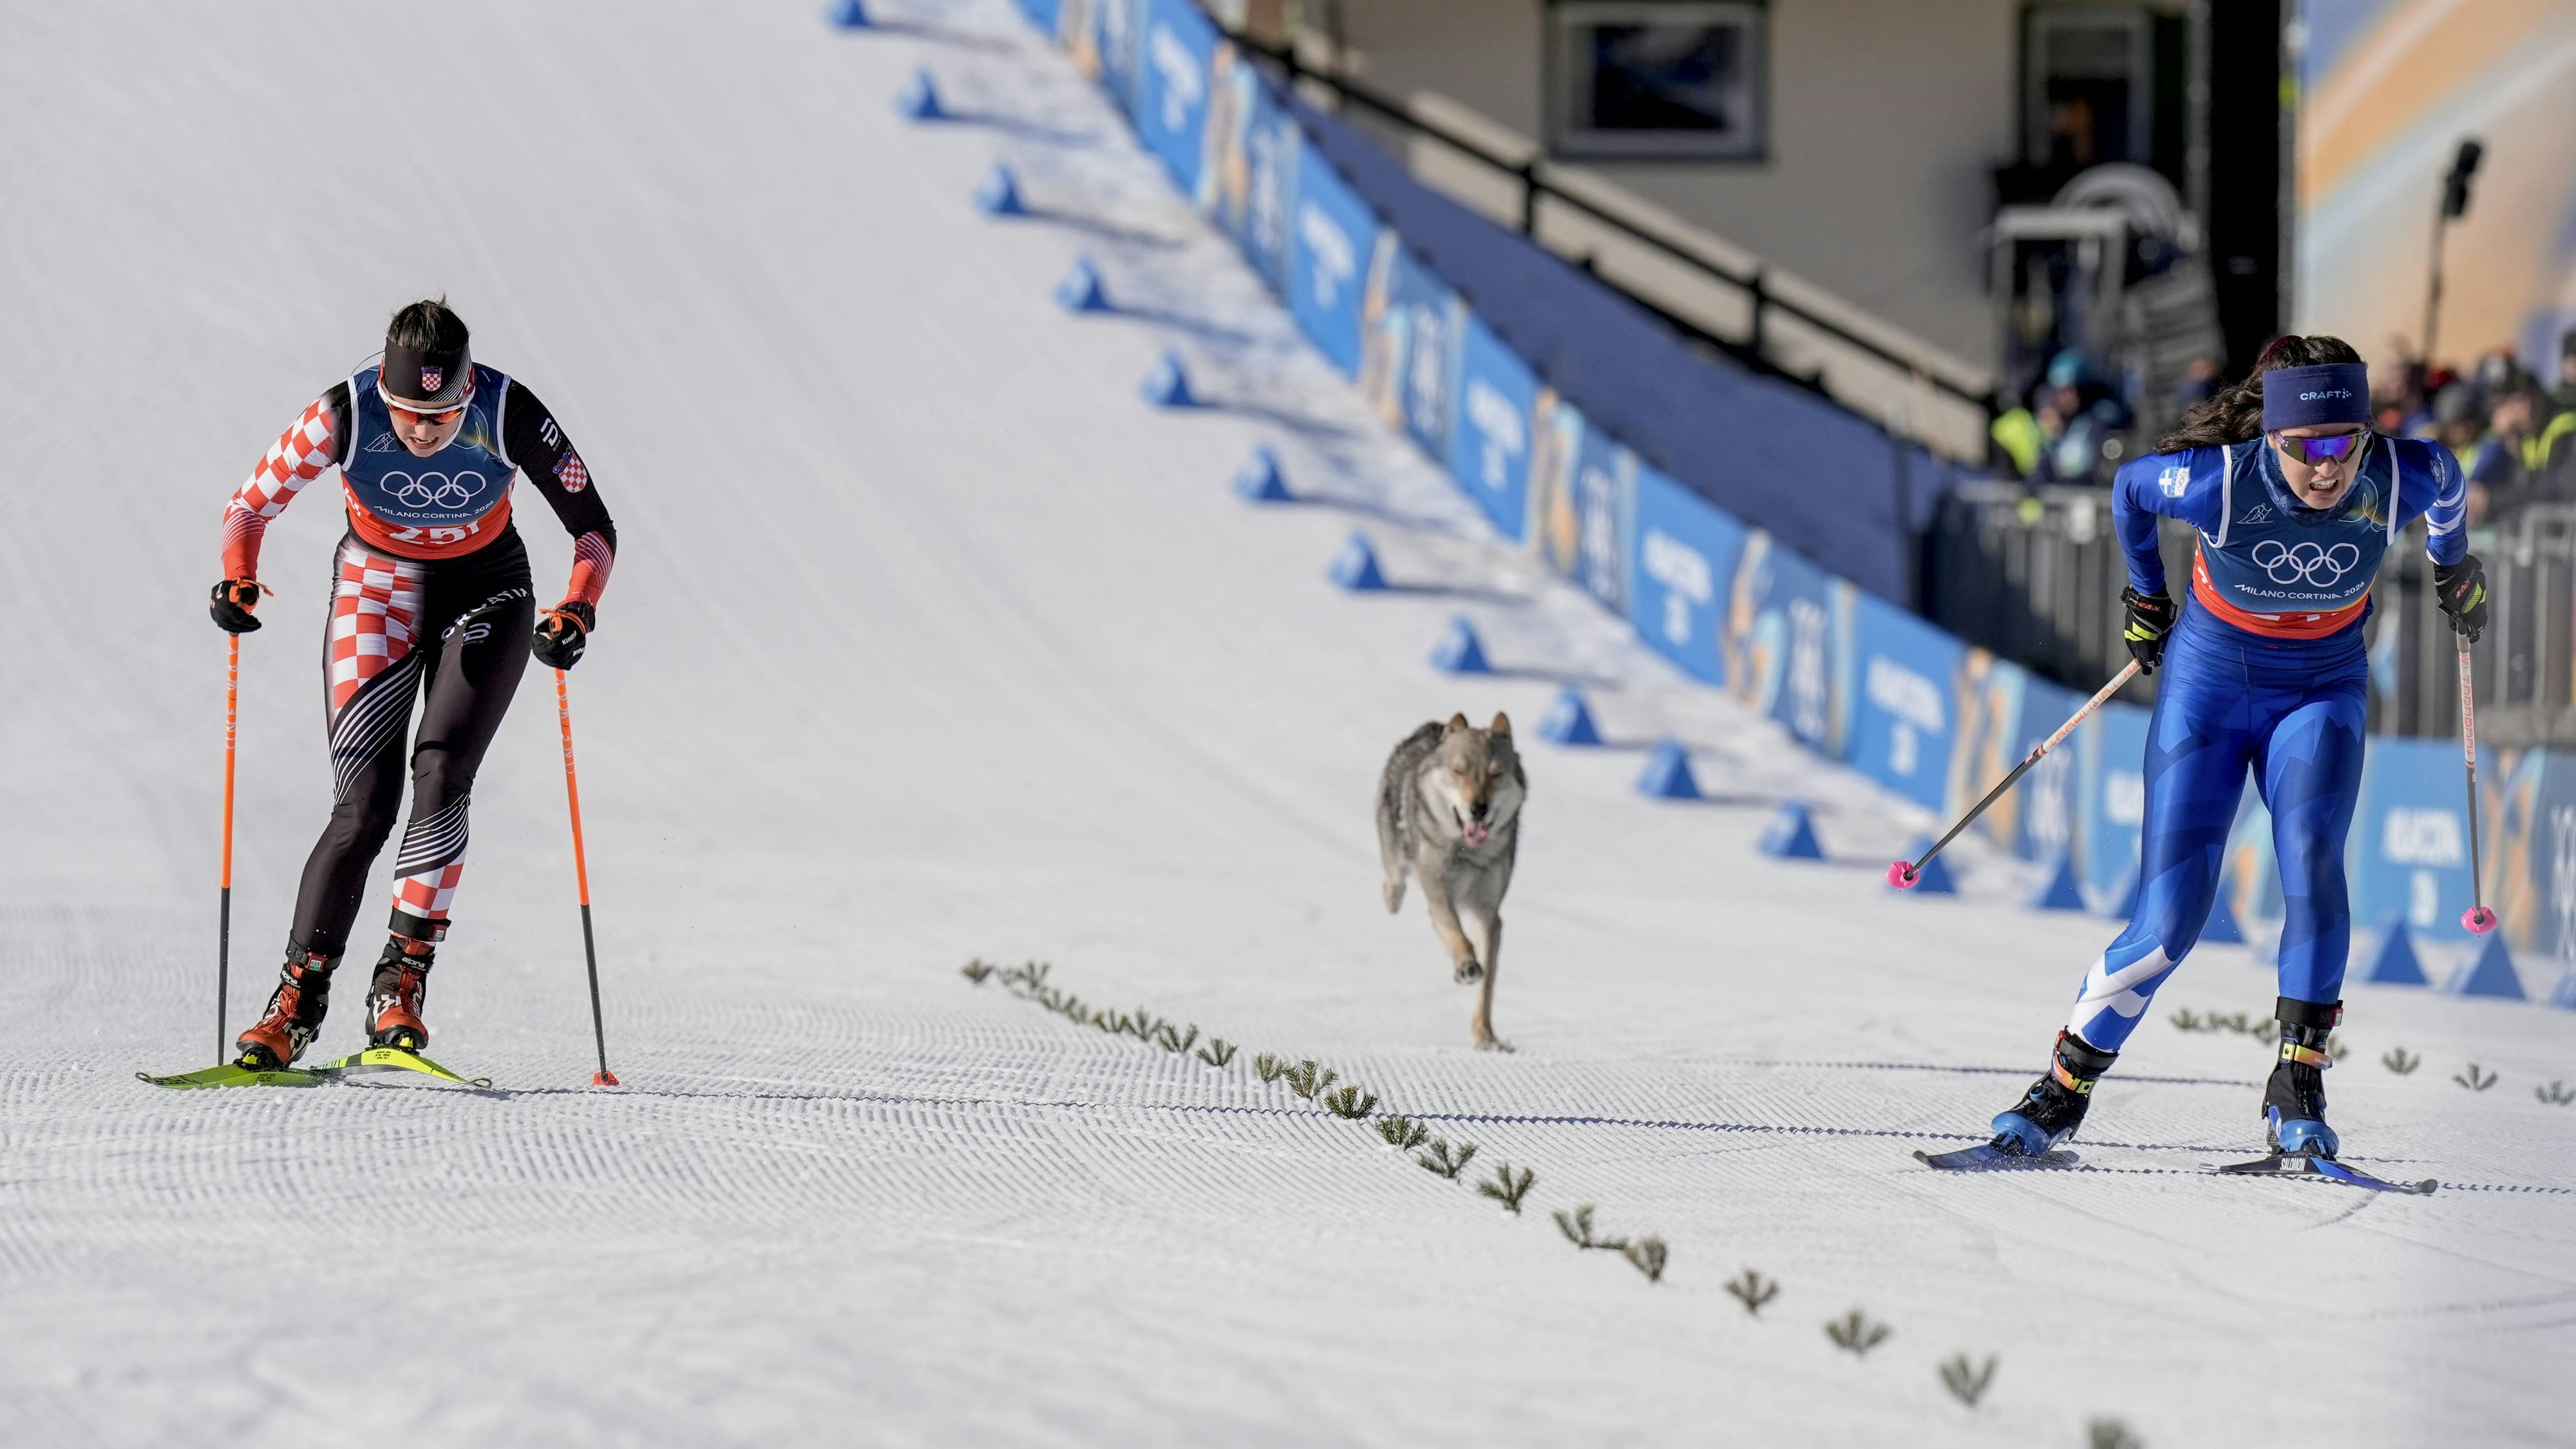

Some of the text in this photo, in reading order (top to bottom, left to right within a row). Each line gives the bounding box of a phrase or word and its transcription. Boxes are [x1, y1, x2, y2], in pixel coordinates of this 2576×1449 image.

[2300, 390, 2341, 401] CRAFT
[374, 506, 421, 518] MILANO
[474, 500, 495, 515] 2026
[2234, 581, 2365, 600] MILANO CORTINA 2026
[401, 956, 425, 969] alpina
[2280, 1157, 2306, 1172] SALOMON
